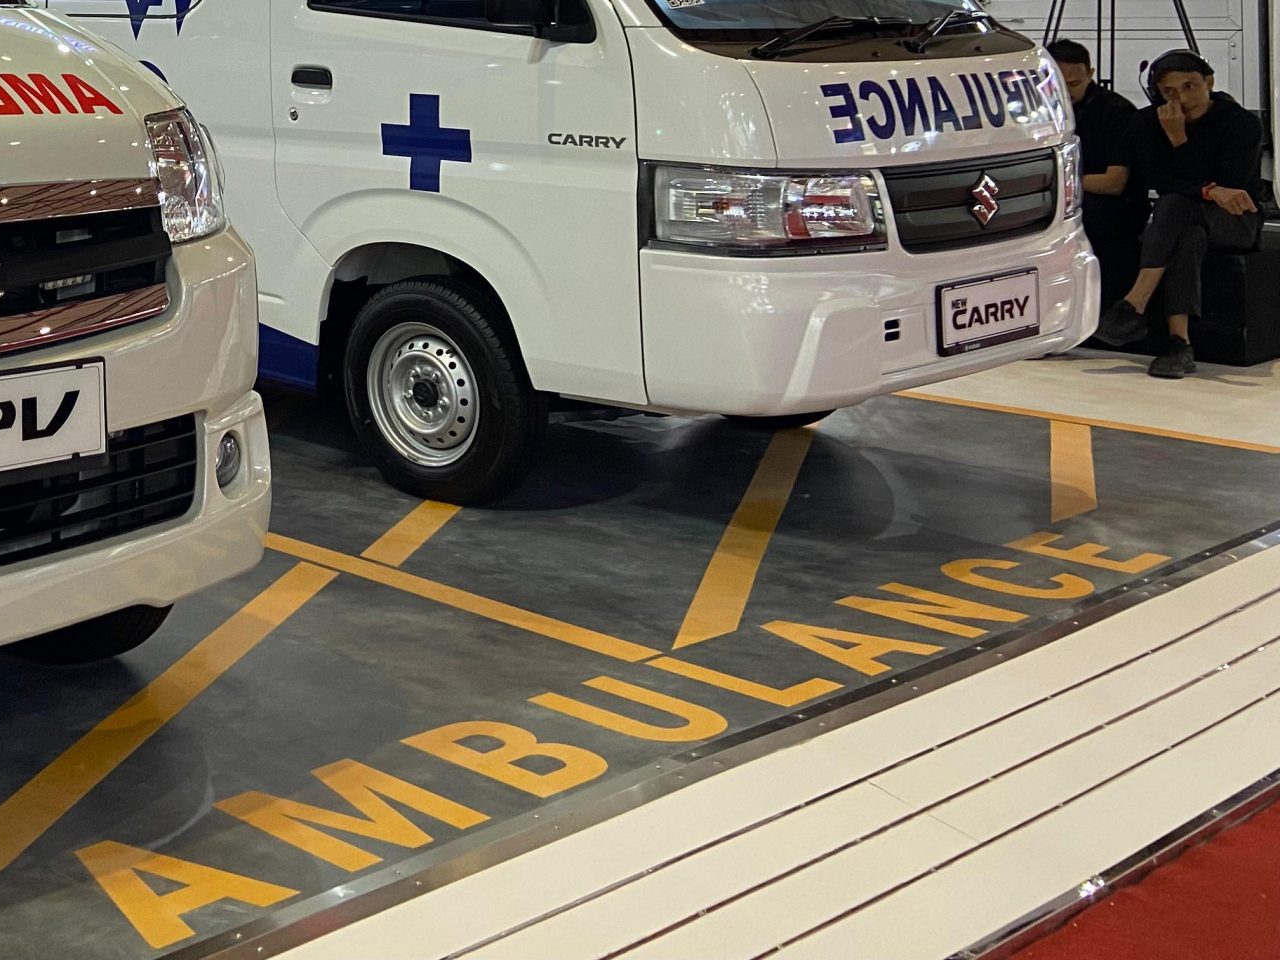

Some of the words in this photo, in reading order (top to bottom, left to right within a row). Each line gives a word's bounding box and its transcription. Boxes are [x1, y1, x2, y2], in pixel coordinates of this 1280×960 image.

[547, 133, 627, 149] CARRY
[951, 297, 968, 310] NEW
[952, 295, 1030, 330] CARRY
[76, 533, 1173, 950] AMBULANCE
